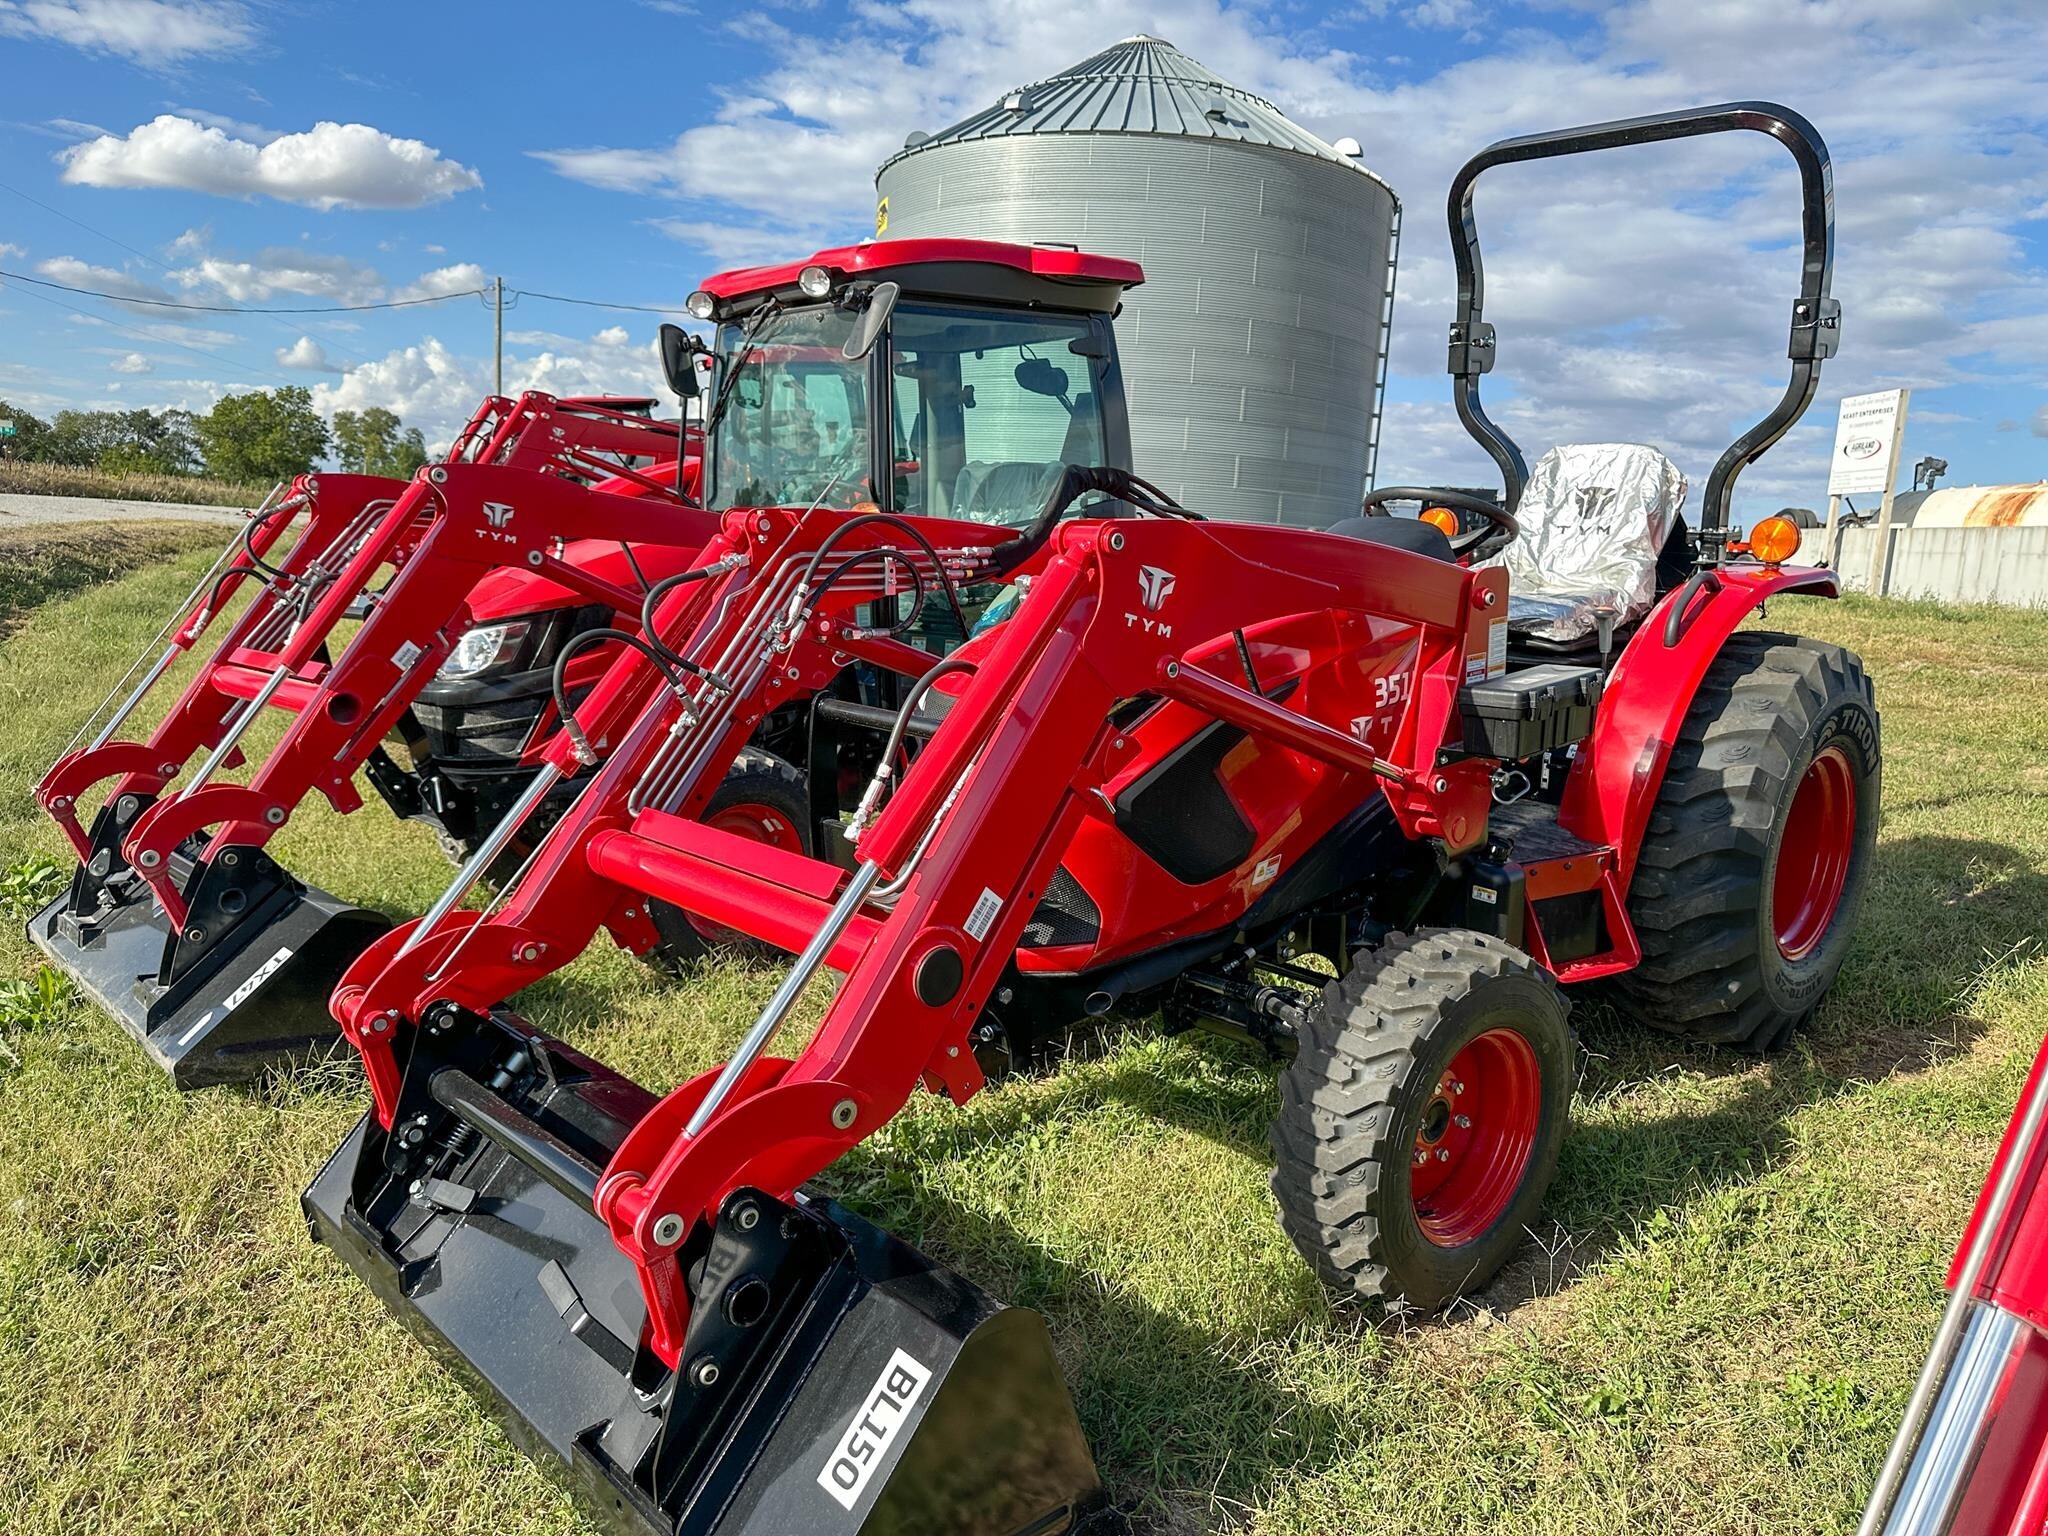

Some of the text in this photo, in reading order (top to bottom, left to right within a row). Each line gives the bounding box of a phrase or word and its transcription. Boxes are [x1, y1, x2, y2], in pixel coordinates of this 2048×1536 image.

[1860, 407, 1893, 417] ENTERPRISES
[475, 529, 516, 544] TYM
[1557, 525, 1610, 535] TYM
[1124, 612, 1172, 638] TYM
[1841, 709, 1878, 771] TIRON
[831, 1364, 918, 1490] BL150
